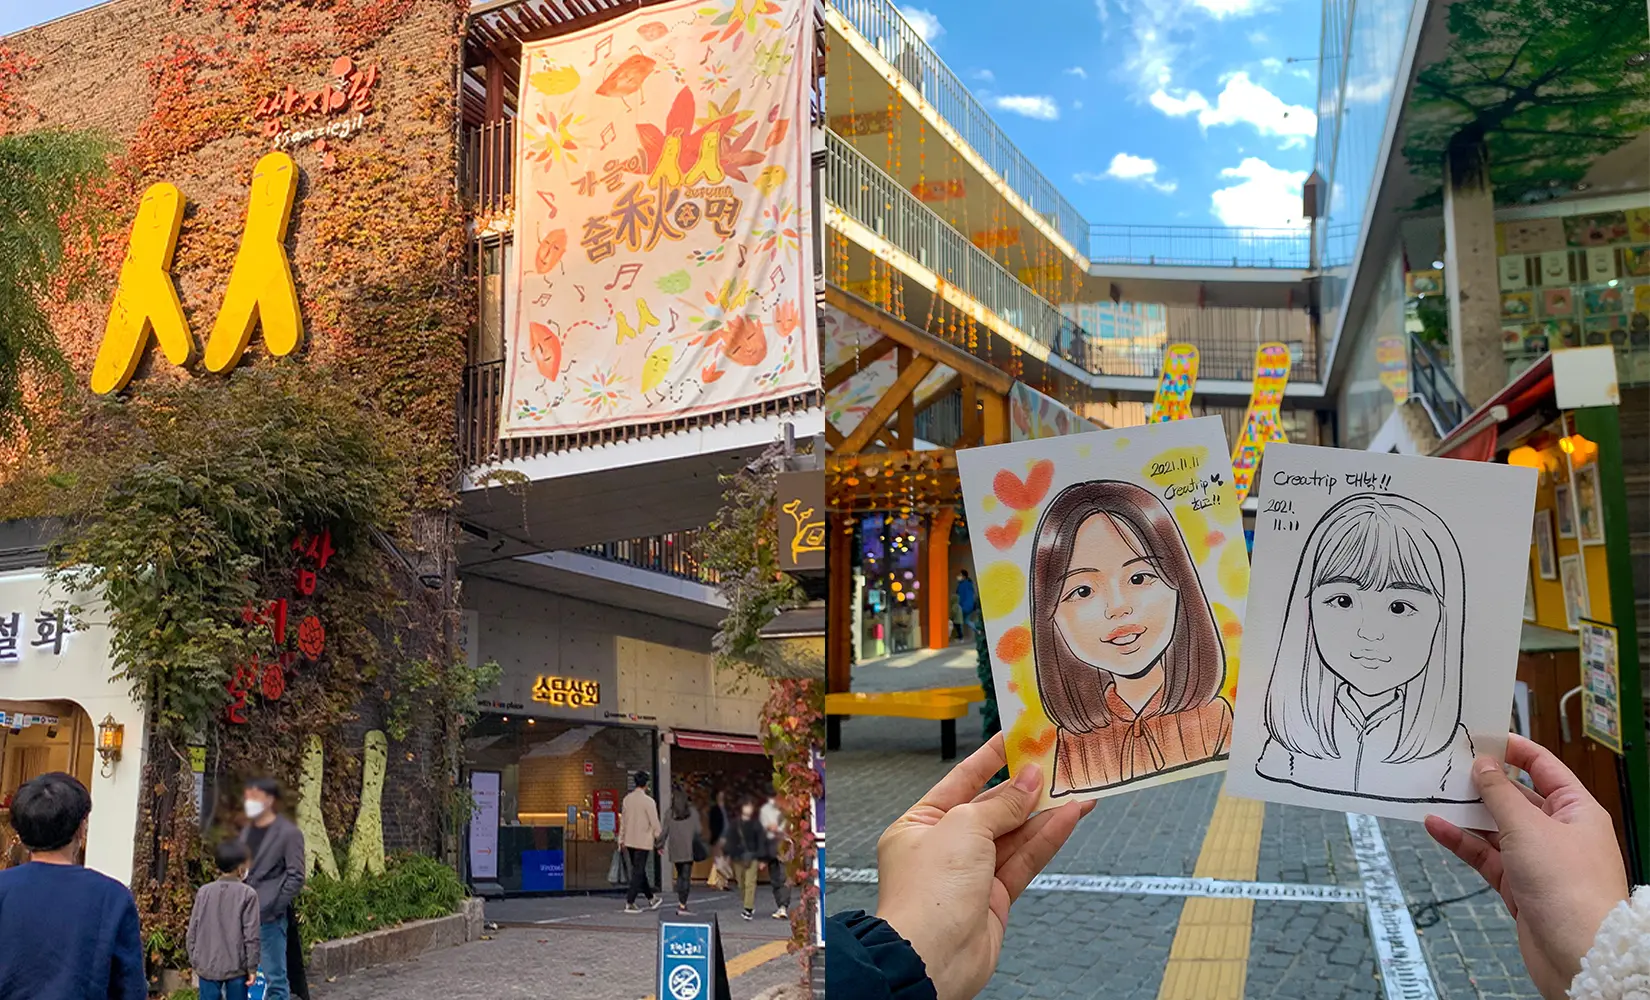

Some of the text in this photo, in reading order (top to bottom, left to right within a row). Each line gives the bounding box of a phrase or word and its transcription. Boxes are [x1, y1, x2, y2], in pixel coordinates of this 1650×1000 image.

[570, 148, 649, 198] 가을이
[1149, 456, 1200, 478] 2021.11.11
[1163, 478, 1209, 501] Creatrip
[1273, 469, 1392, 495] Creatrip 대박!!
[1262, 499, 1296, 515] 2021.
[1273, 519, 1300, 531] 11.11
